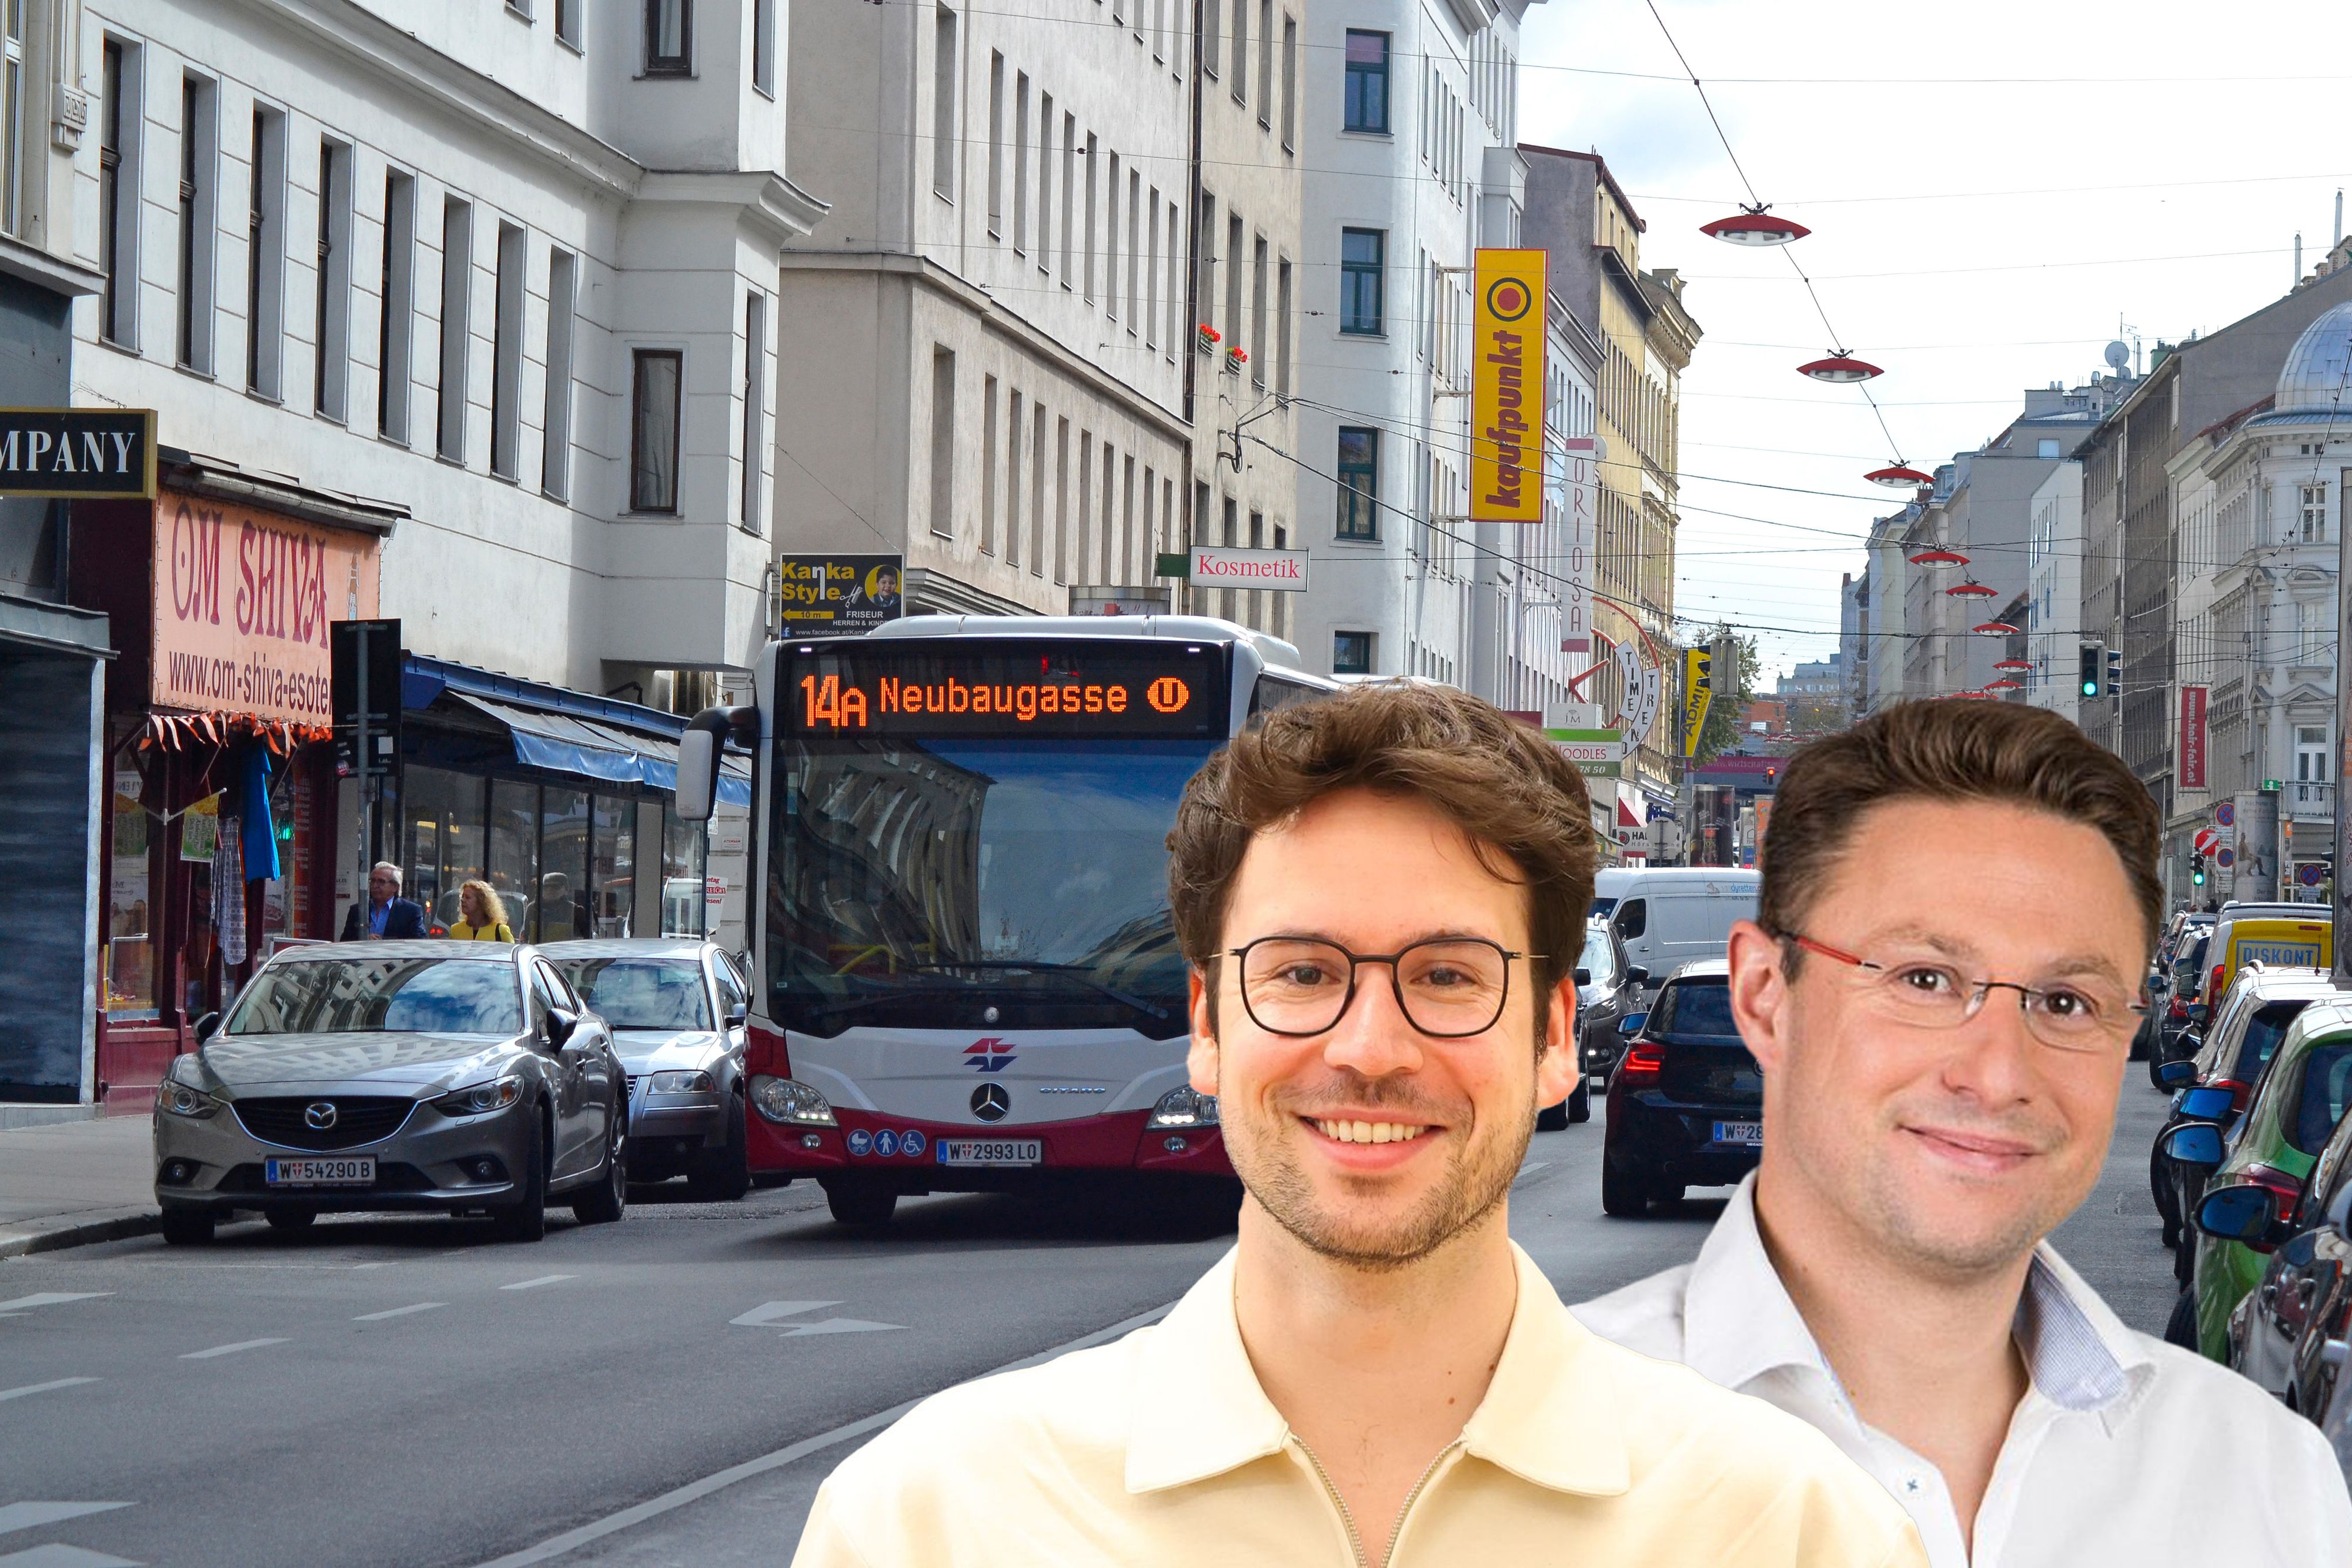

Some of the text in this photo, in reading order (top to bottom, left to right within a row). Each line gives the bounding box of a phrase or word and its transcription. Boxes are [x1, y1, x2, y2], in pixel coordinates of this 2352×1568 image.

[1485, 330, 1528, 508] kaufpunkt
[1571, 457, 1589, 632] ORIOSA
[172, 503, 328, 650] OM SHIVA
[782, 562, 854, 580] Kanka
[1197, 554, 1301, 579] Kosmetik
[782, 583, 841, 604] Style
[1625, 652, 1639, 711] TIME
[801, 674, 866, 726] 14A
[881, 677, 1128, 721] Neubaugasse
[1622, 675, 1655, 755] TREND
[2243, 947, 2313, 965] DISKONT
[1725, 1124, 1735, 1139] W
[950, 1144, 961, 1159] W
[280, 1163, 291, 1179] W
